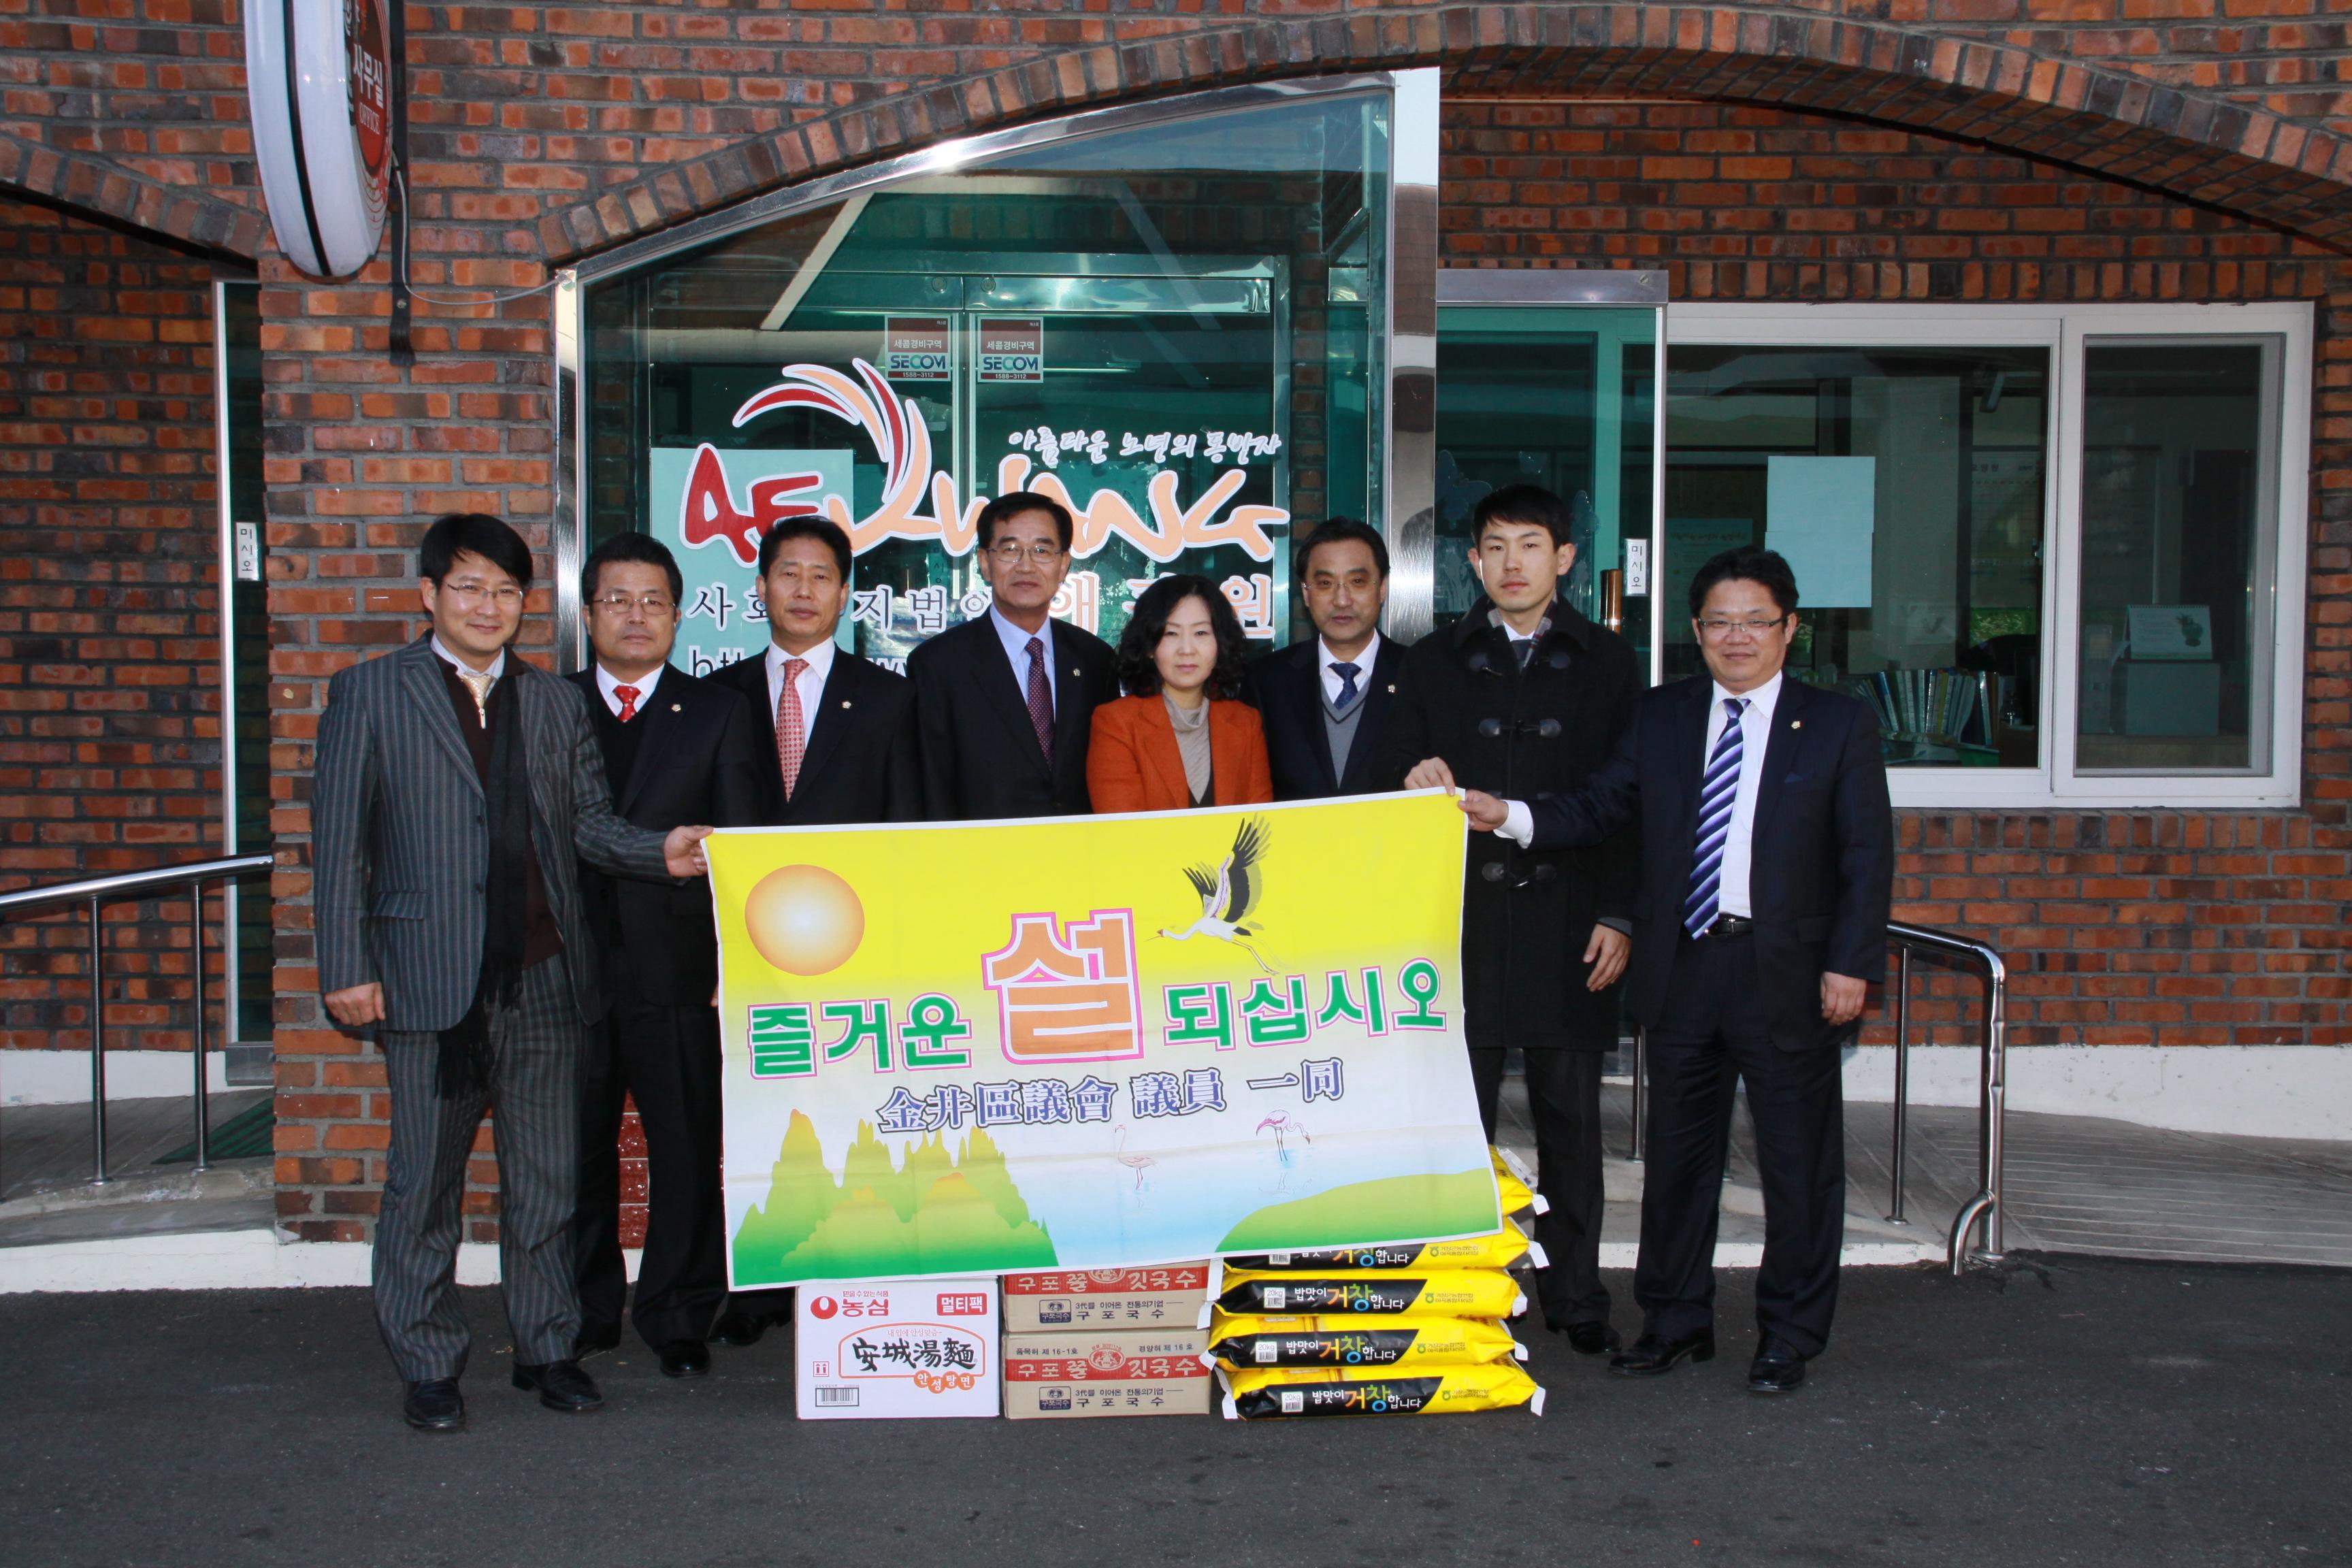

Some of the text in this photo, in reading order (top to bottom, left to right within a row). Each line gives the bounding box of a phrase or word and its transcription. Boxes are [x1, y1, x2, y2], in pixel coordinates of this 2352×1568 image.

[353, 44, 384, 109] 사무실
[359, 102, 381, 135] OFFICE
[894, 340, 942, 349] 세콤경비구역
[987, 341, 1034, 350] 세콤경비구역
[890, 355, 946, 370] SECOM
[983, 356, 1039, 371] SECOM
[1009, 426, 1281, 466] 아름다운 노년의 동반자
[240, 529, 253, 571] 미시오
[1631, 546, 1642, 587] 미시오
[747, 908, 1447, 1080] 즐거운 설 되십시오
[877, 1075, 1118, 1133] 金井區議會
[1129, 1066, 1227, 1118] 議員
[1267, 1289, 1284, 1297] 20kg
[842, 1298, 889, 1317] 농심
[941, 1295, 983, 1313] 멀티팩
[1100, 1301, 1122, 1309] 이어온
[852, 1337, 977, 1372] 安城湯麵
[1258, 1344, 1275, 1353] 20kg
[917, 1372, 971, 1392] 안성탕면
[1284, 1394, 1301, 1402] 20kg
